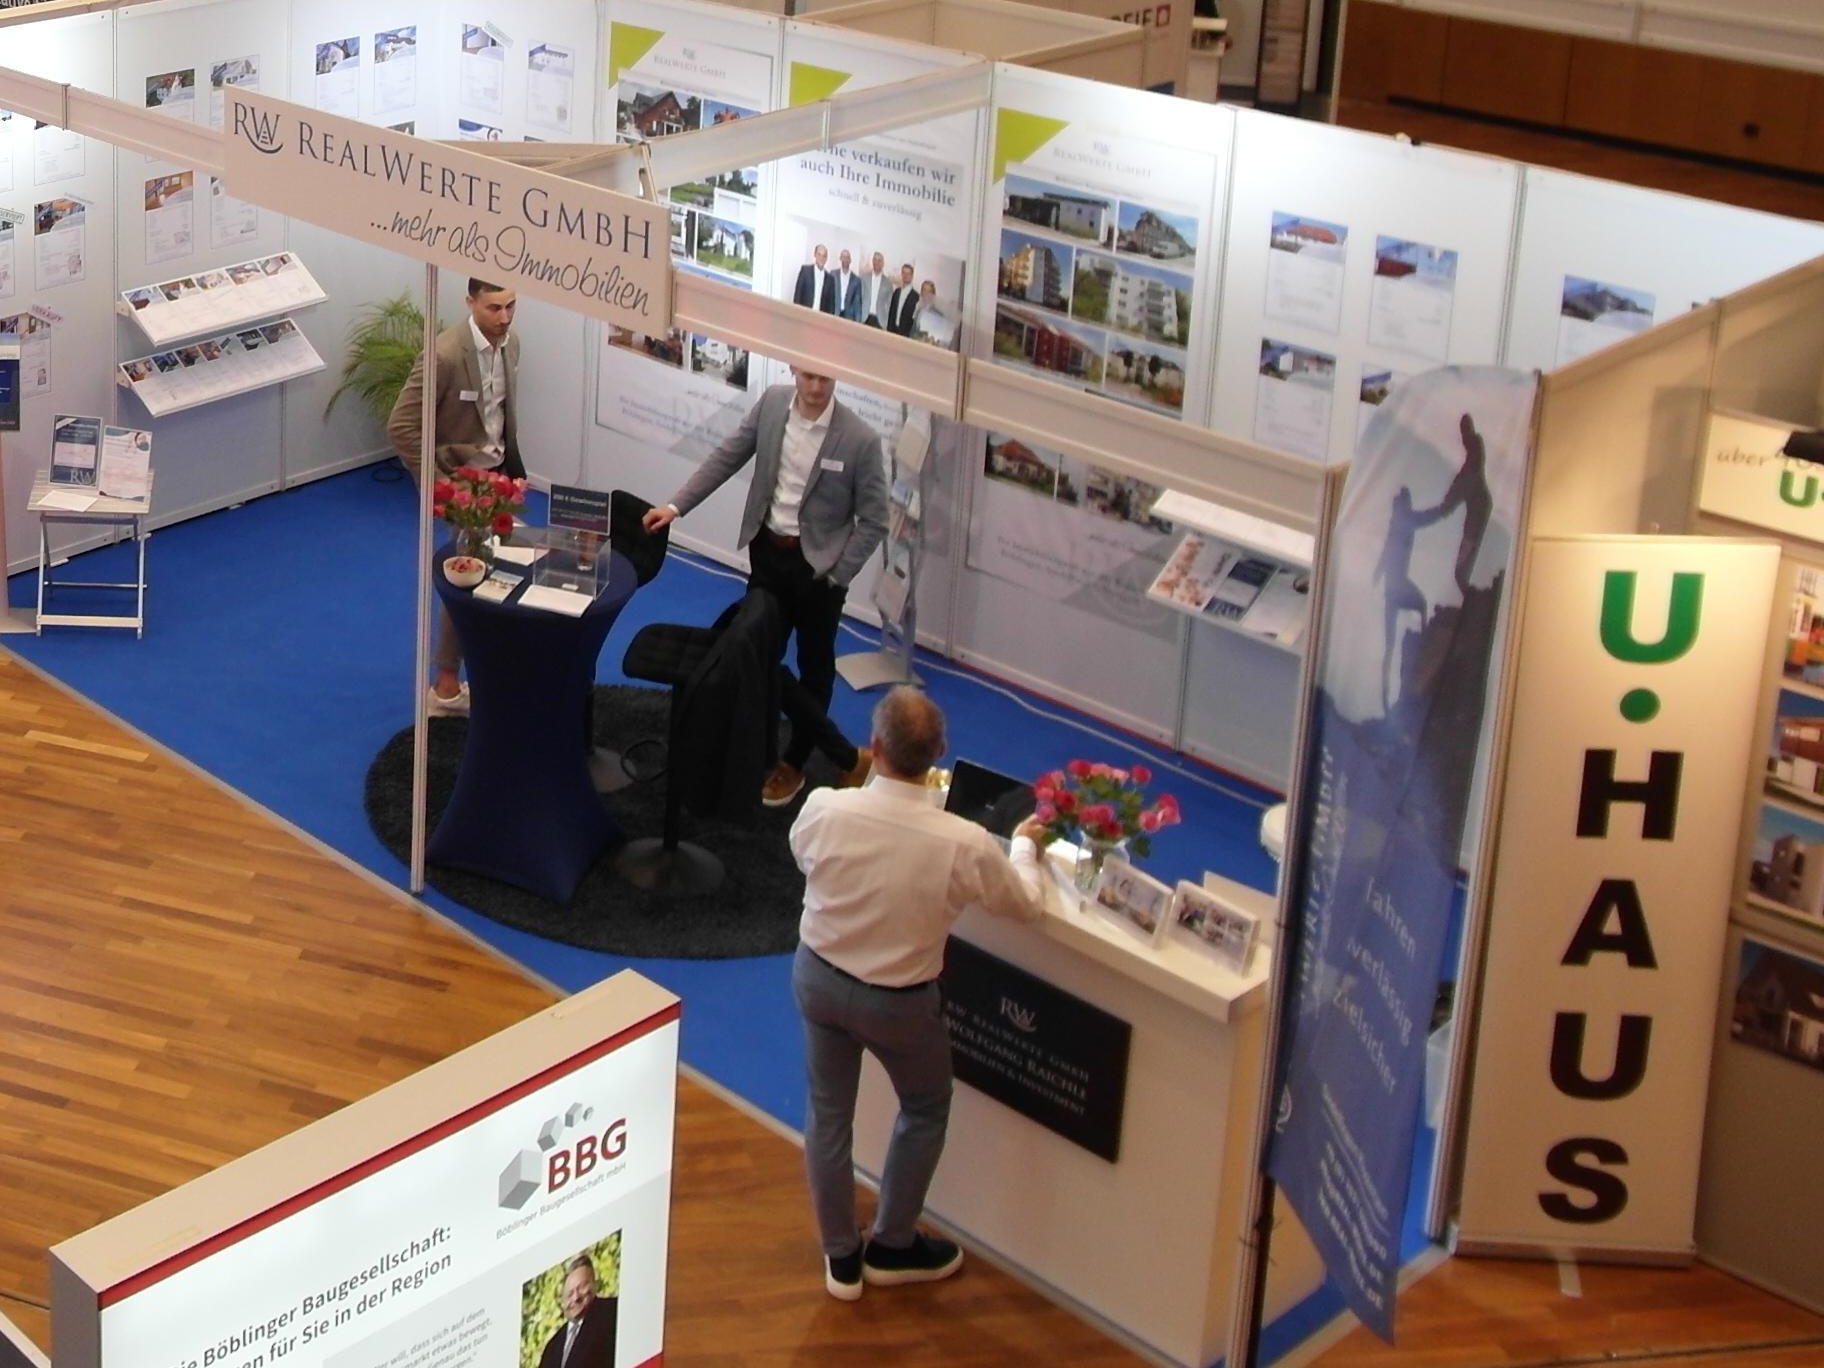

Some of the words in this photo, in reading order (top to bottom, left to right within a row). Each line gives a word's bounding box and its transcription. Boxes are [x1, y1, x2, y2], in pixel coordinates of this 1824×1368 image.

[233, 102, 284, 154] RW
[800, 157, 835, 177] auch
[840, 164, 870, 185] Ihre
[875, 172, 956, 207] Immobilie
[851, 149, 925, 178] verkaufen
[931, 167, 956, 184] wir
[828, 187, 860, 204] schnell
[862, 196, 870, 206] &
[872, 199, 923, 222] zuverlässig
[447, 221, 490, 263] als
[493, 225, 649, 317] Immobilien
[945, 1017, 1024, 1066] WOLFGANG
[1027, 1057, 1087, 1100] RAICHLE
[547, 1118, 627, 1195] BBG
[496, 1212, 537, 1239] Böblinger
[540, 1175, 604, 1216] Baugesellschaft
[606, 1162, 626, 1180] mbH
[203, 1305, 298, 1368] Böblinger
[302, 1226, 452, 1317] Baugesellschaft:
[270, 1336, 297, 1366] für
[302, 1319, 330, 1345] Sie
[335, 1307, 352, 1328] in
[356, 1288, 388, 1316] der
[391, 1254, 452, 1298] Region
[390, 1350, 409, 1366] will,
[410, 1339, 430, 1356] dass
[432, 1327, 449, 1344] sich
[450, 1316, 465, 1333] auf
[466, 1307, 486, 1324] dem
[432, 1338, 457, 1357] etwas
[456, 1342, 472, 1358] das
[473, 1333, 489, 1348] tun
